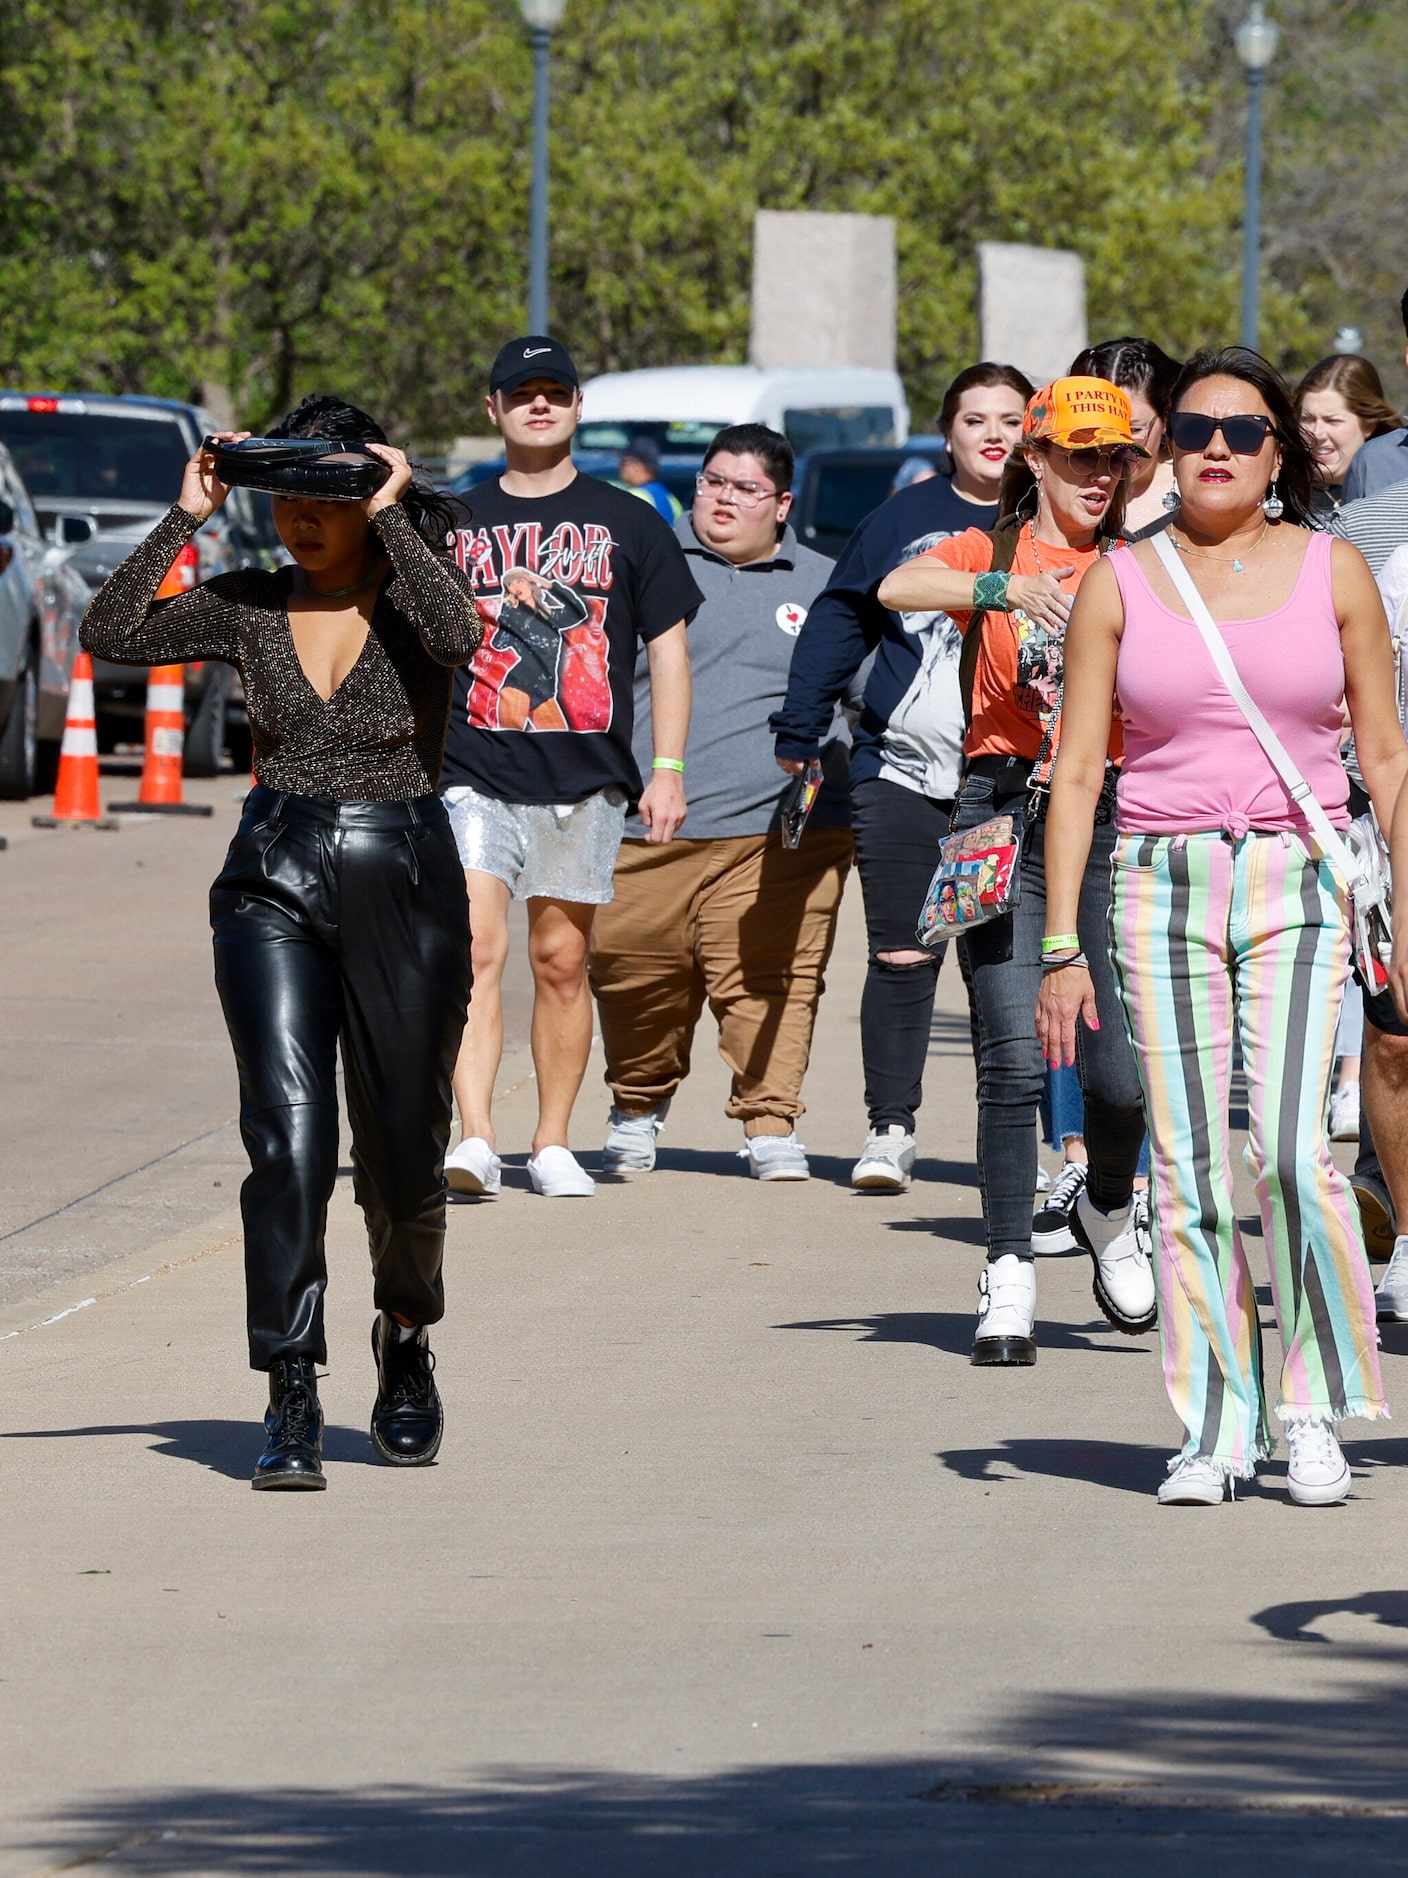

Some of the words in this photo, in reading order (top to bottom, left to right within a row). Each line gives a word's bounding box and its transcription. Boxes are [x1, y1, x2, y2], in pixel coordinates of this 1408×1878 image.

[1066, 393, 1071, 402] I
[1075, 390, 1117, 403] PARTY
[1070, 403, 1105, 413] THIS
[1108, 405, 1128, 421] HAT
[446, 522, 614, 590] TAYLOR
[536, 535, 620, 577] Swift
